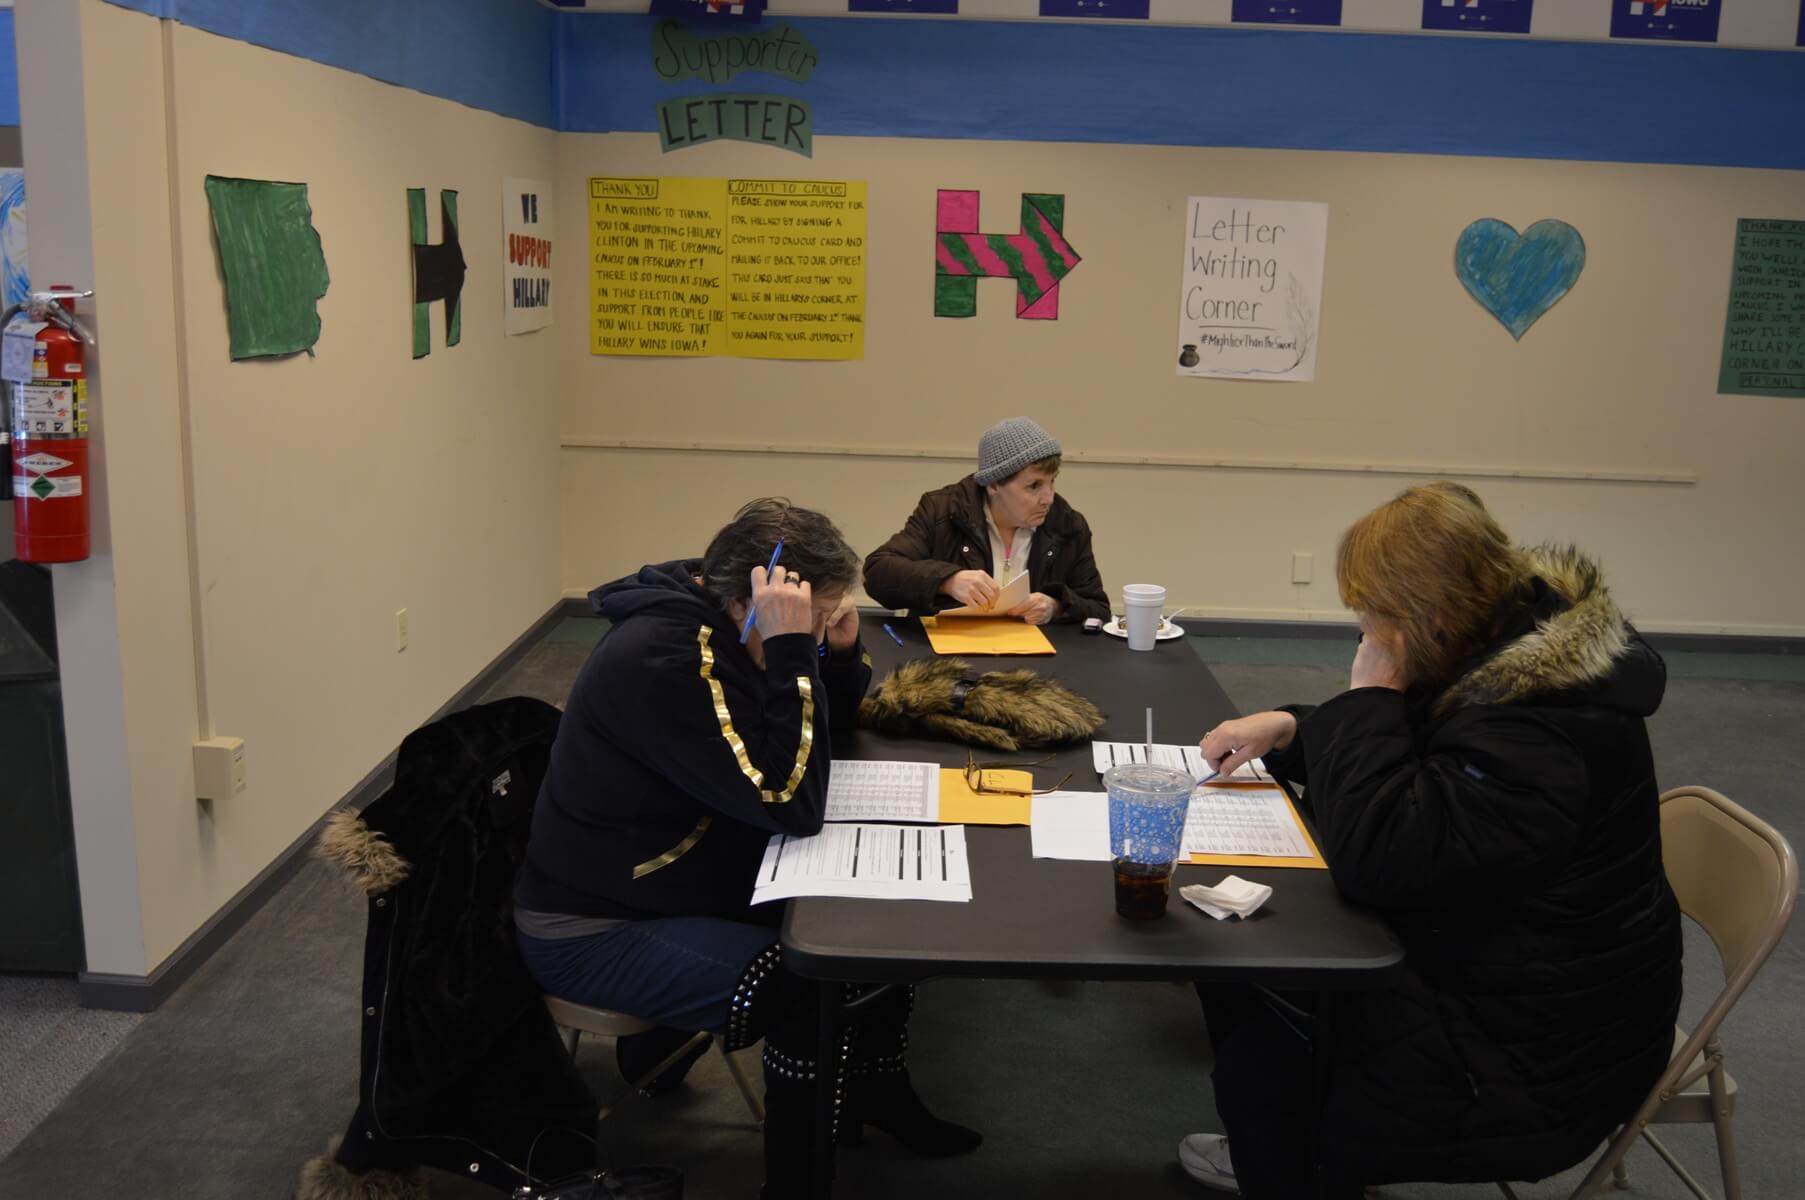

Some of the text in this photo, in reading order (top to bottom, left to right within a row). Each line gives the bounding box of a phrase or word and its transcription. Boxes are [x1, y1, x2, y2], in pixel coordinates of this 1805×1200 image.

[662, 100, 806, 149] LETTER
[594, 181, 655, 197] THANK YOU
[729, 182, 843, 195] COMMIT TO CAUCUS
[521, 193, 538, 224] WE
[605, 203, 618, 213] AM
[620, 206, 661, 216] WRITING
[664, 208, 675, 217] TO
[680, 209, 711, 219] THANK
[731, 197, 864, 210] PLEASE SHOW YOUR SUPPORT FOR
[731, 215, 842, 227] FOR HILLARY BY SIGNING A
[1192, 202, 1286, 244] Letter
[596, 221, 721, 239] YOU FOR SUPPORTING HILLARY
[596, 236, 724, 255] CLINTON IN THE UPCOMING
[731, 234, 863, 247] COMMIT TO CAUCUS CARD AND
[1752, 237, 1781, 248] HOPE
[509, 233, 551, 269] SUPPORT
[595, 254, 624, 264] CAUCUS
[627, 256, 639, 266] ON
[642, 256, 686, 268] FEBRUARY
[731, 255, 761, 265] MAILING
[774, 255, 795, 265] BACK
[797, 255, 809, 265] TO
[810, 255, 826, 265] OUR
[829, 255, 861, 266] OFFICE!
[1191, 246, 1277, 293] Writing
[596, 270, 719, 289] THERE IS SO MUCH AT STAKE
[774, 274, 793, 284] JUST
[813, 275, 833, 285] THAT
[836, 275, 853, 285] YOU
[598, 288, 709, 305] IN THIS ELECTION AND
[730, 292, 748, 302] WILL
[752, 292, 761, 302] BE
[763, 292, 771, 302] IN
[845, 295, 859, 304] AT
[1185, 285, 1263, 322] Corner
[597, 303, 637, 314] SUPPORT
[641, 305, 665, 317] FROM
[669, 307, 705, 320] PEOPLE
[731, 311, 747, 321] THE
[776, 313, 788, 322] ON
[790, 313, 827, 322] FEBRUARY
[597, 319, 711, 335] YOU WILL ENSURE THAT
[1730, 326, 1757, 337] WHY
[598, 336, 707, 352] HILLARY WINS IOWA!
[731, 330, 854, 344] YOU AGAIN FOR YOUR SUPPORT!
[1729, 339, 1792, 354] HILLARY
